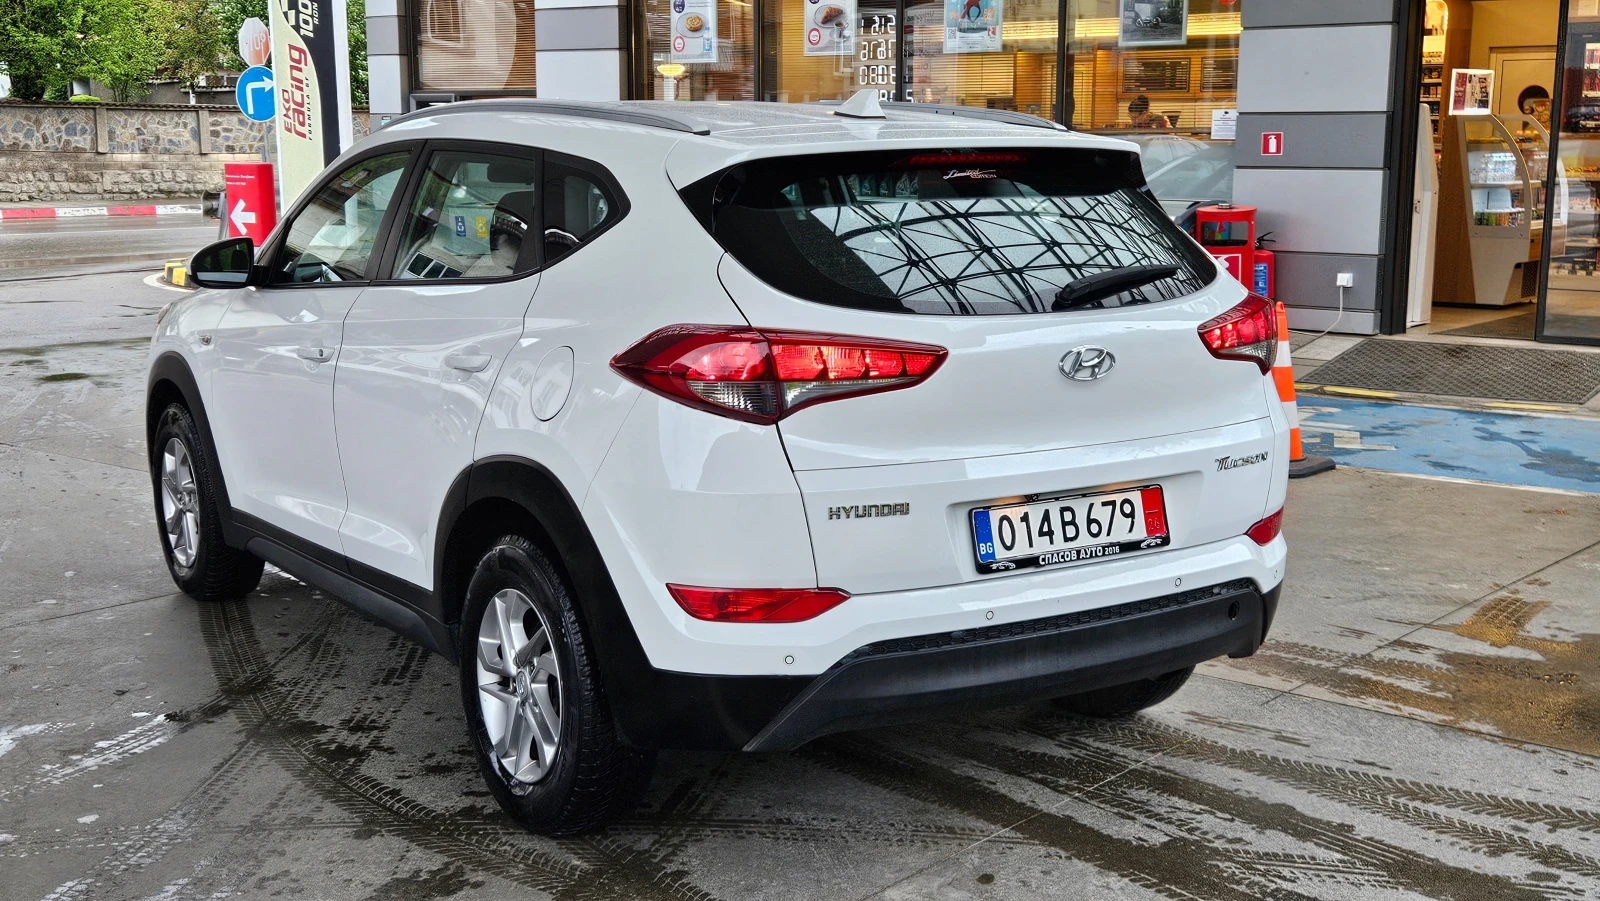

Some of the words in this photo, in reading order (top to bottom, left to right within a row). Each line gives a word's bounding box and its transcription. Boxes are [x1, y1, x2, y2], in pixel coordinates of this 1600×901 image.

[298, 0, 314, 38] 100
[287, 43, 308, 139] racing
[282, 88, 293, 134] EKO
[828, 502, 910, 520] HYUNDAI
[979, 542, 993, 555] BG
[1039, 549, 1077, 565] СПАСОВ
[1079, 546, 1103, 559] АУТО
[1104, 546, 1120, 555] 2016
